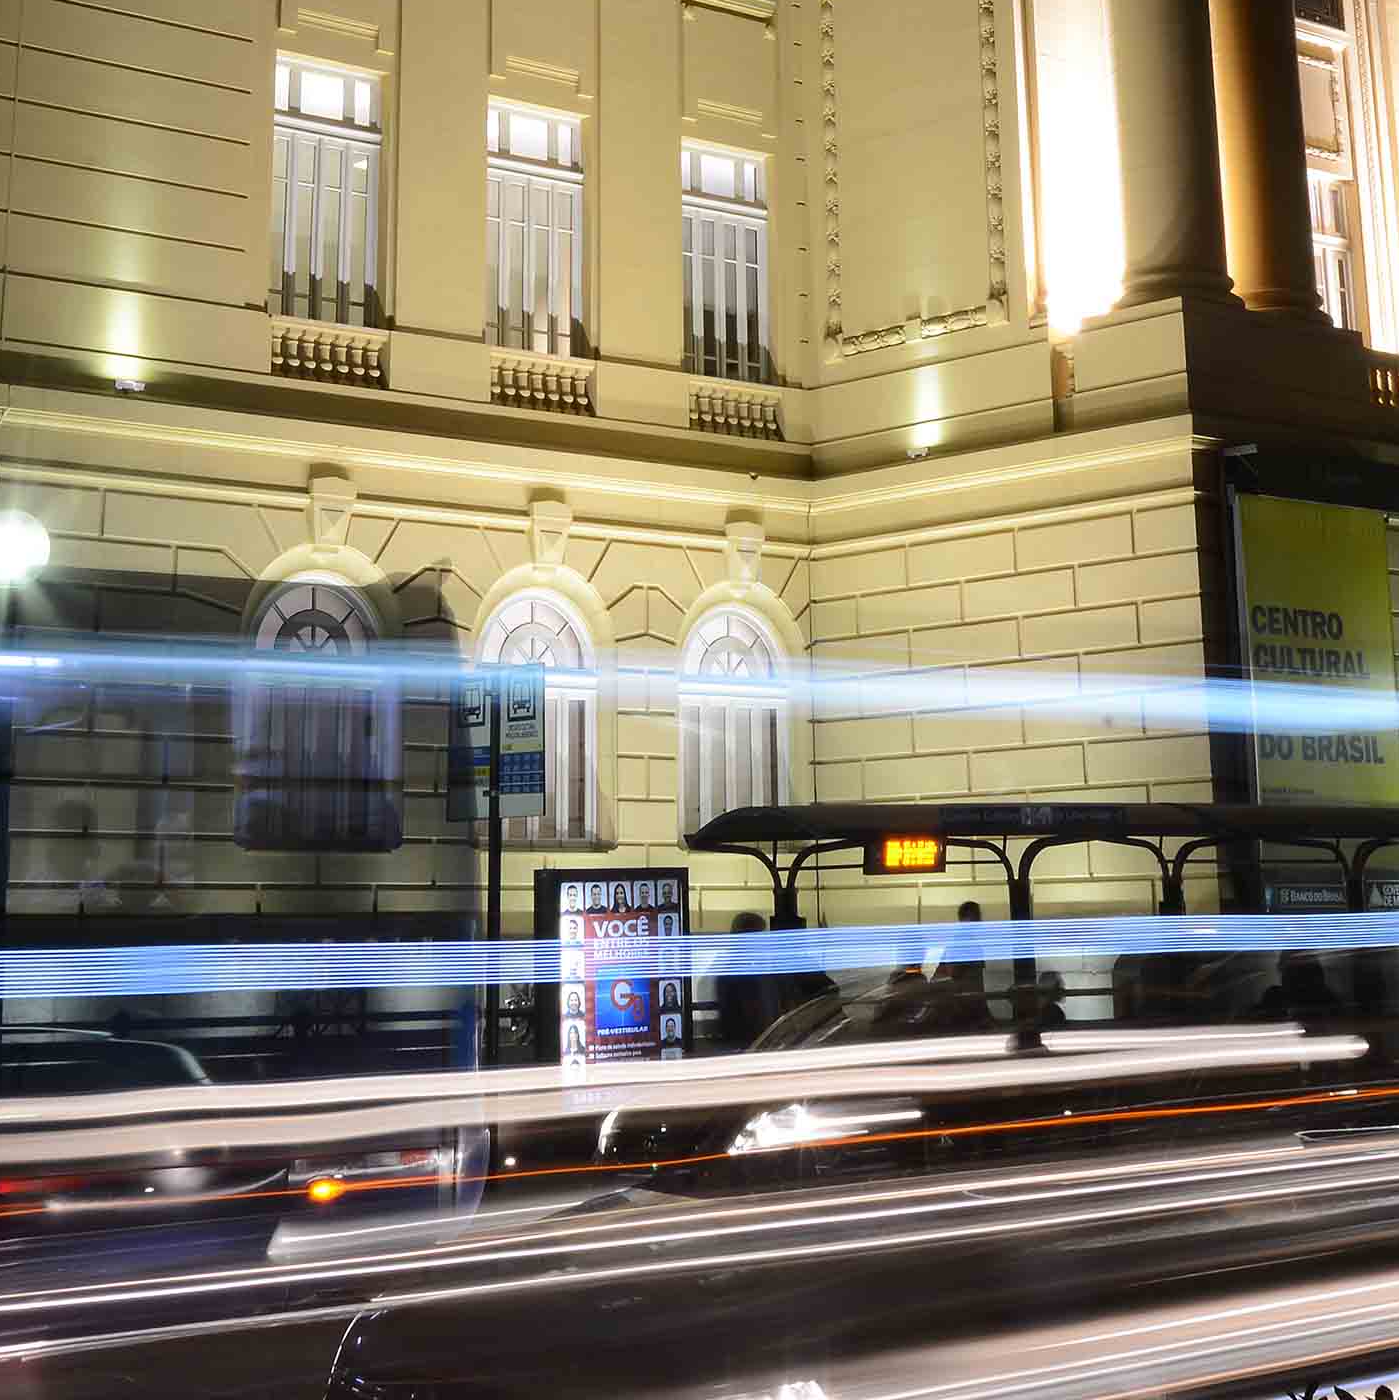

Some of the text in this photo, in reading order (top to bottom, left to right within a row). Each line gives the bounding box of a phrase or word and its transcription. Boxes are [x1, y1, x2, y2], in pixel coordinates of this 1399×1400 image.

[1253, 605, 1343, 640] CENTRO
[1254, 644, 1370, 679] CULTURAL
[1258, 733, 1385, 765] DO BRASIL
[593, 915, 650, 938] VOCÊ
